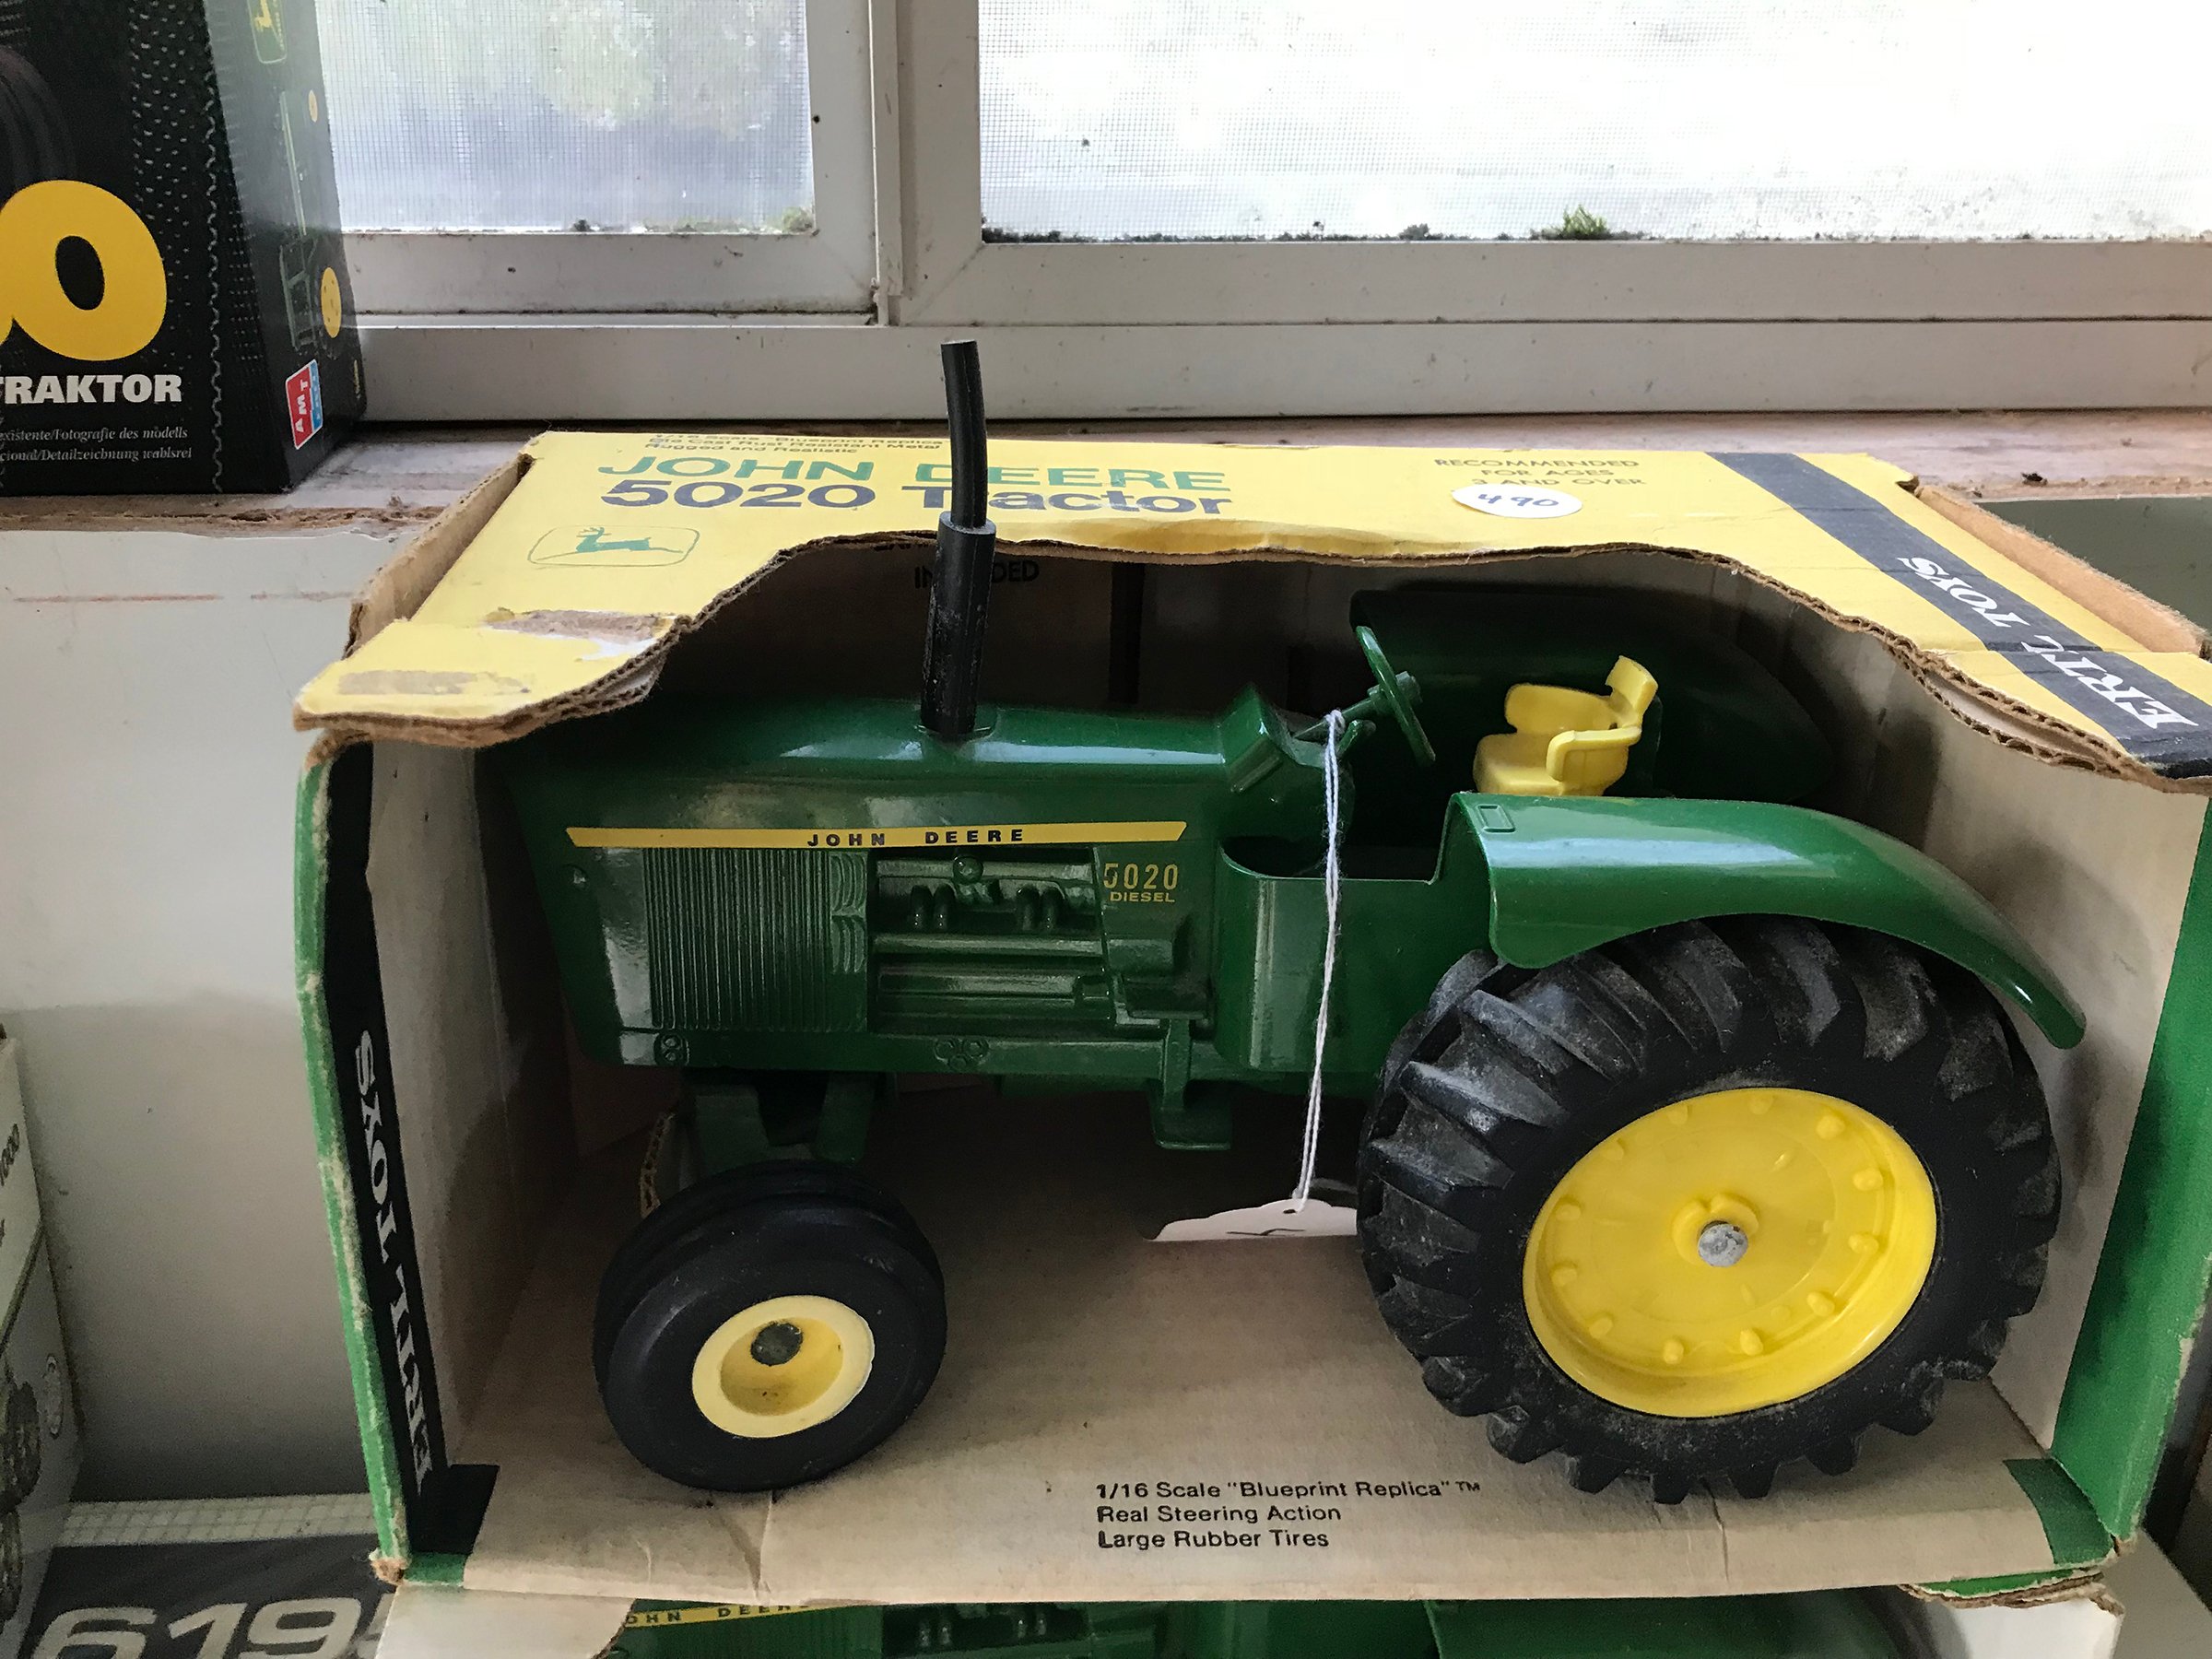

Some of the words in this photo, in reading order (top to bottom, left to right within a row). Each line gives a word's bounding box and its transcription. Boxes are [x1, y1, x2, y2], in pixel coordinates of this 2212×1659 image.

[0, 180, 168, 361] 0
[0, 374, 182, 405] RAKTOR
[295, 379, 310, 433] AMT
[119, 428, 139, 440] des
[597, 455, 875, 481] JOHN
[914, 463, 1230, 491] DEERE
[1434, 459, 1639, 467] RECOMMENDED
[600, 479, 876, 509] 5020
[900, 485, 1233, 514] Tactor
[1897, 557, 2030, 628] TOYS
[2020, 635, 2199, 729] ERTL
[807, 832, 886, 847] JOHN
[924, 829, 1024, 845] DEERE
[1103, 862, 1179, 890] 5020
[1109, 891, 1175, 903] DIESEL
[356, 1030, 397, 1264] TOYS
[390, 1265, 433, 1497] ERTL
[1096, 1482, 1148, 1500] 1/16
[1156, 1481, 1221, 1499] Scale
[1228, 1480, 1348, 1500] "Blueprint
[1097, 1505, 1148, 1523] Real
[1158, 1504, 1259, 1524] Steering
[1267, 1504, 1342, 1522] Action
[1098, 1530, 1166, 1550] Large
[1174, 1530, 1262, 1548] Rubber
[1269, 1529, 1330, 1548] Tires
[32, 1594, 394, 1659] 619
[626, 1611, 681, 1625] OHN
